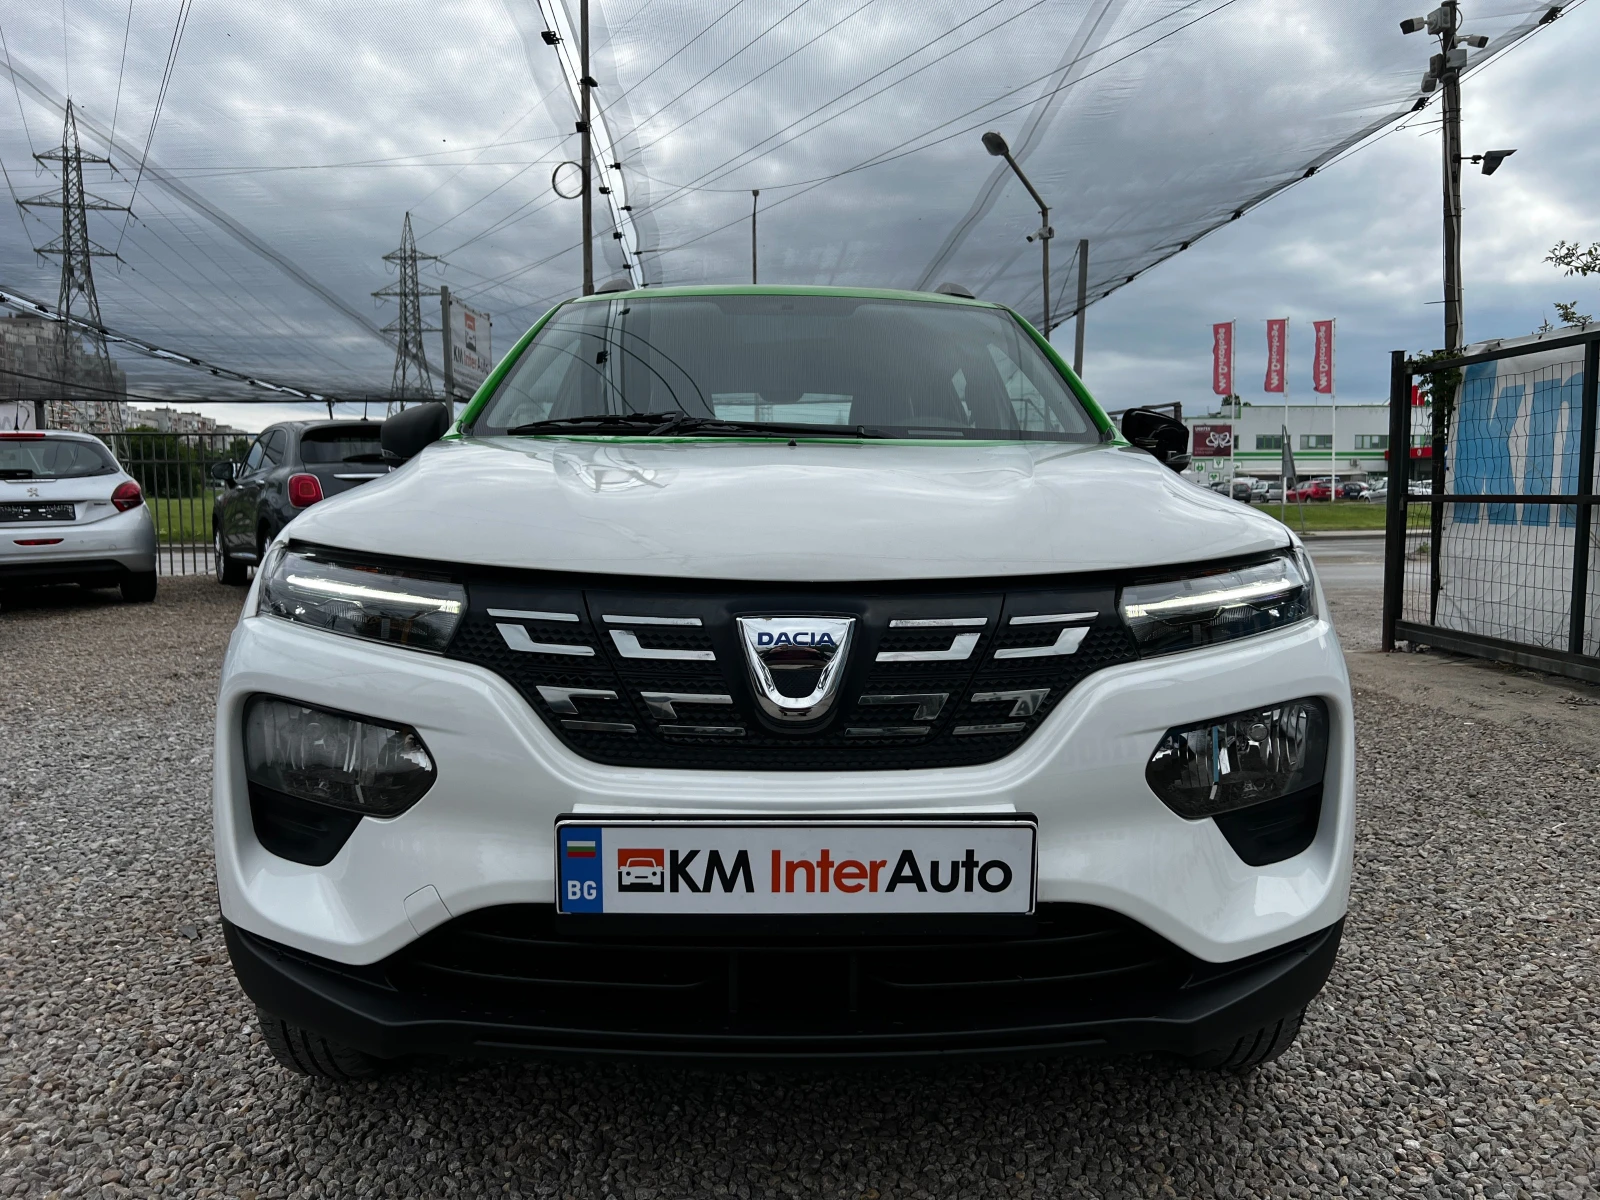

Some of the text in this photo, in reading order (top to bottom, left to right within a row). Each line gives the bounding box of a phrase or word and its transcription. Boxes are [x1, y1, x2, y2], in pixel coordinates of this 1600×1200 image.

[453, 344, 464, 365] KM
[757, 632, 836, 646] DACIA
[669, 849, 1013, 893] KM InterAuto
[567, 880, 597, 900] BG
